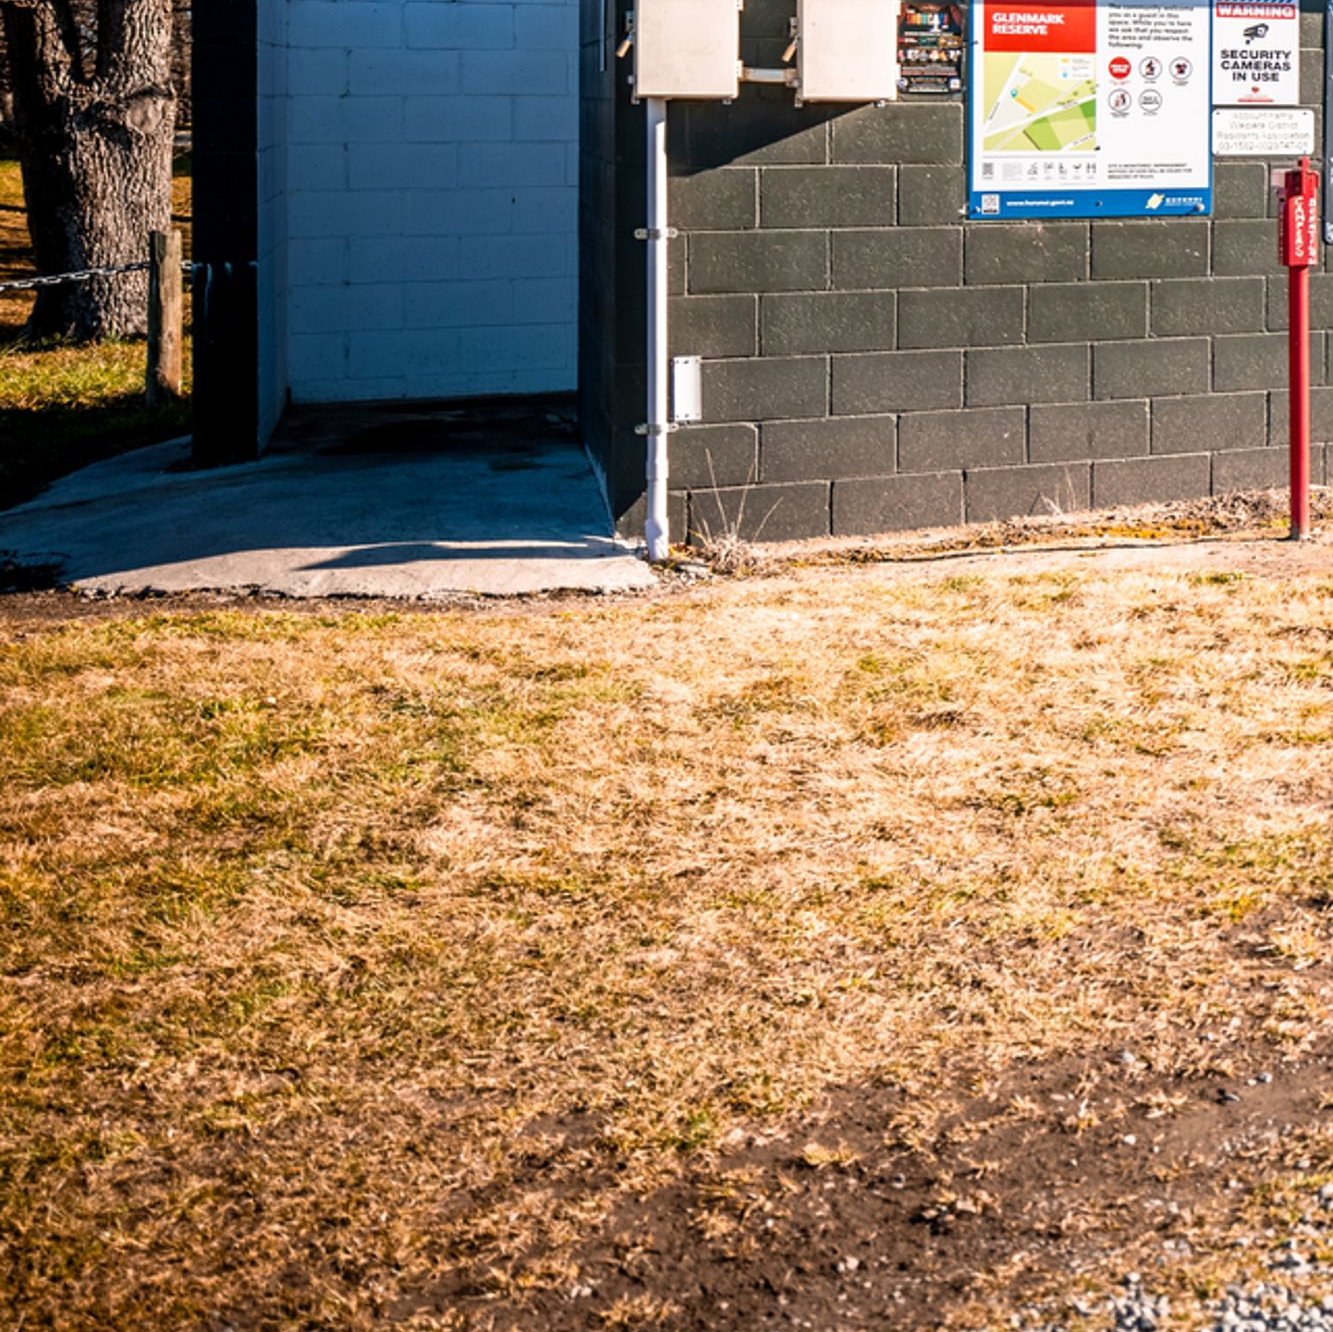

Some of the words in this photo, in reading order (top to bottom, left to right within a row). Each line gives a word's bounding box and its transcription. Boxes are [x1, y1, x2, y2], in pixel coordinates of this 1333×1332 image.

[1218, 3, 1293, 17] WARNING
[992, 12, 1064, 24] GLENMARK
[1139, 12, 1157, 20] guest
[992, 24, 1048, 35] RESERVE
[1164, 28, 1189, 36] respect
[1220, 49, 1292, 60] SECURITY
[1220, 60, 1292, 71] CAMERAS
[1232, 72, 1247, 81] IN
[1251, 72, 1280, 82] USE
[1262, 130, 1310, 140] Association
